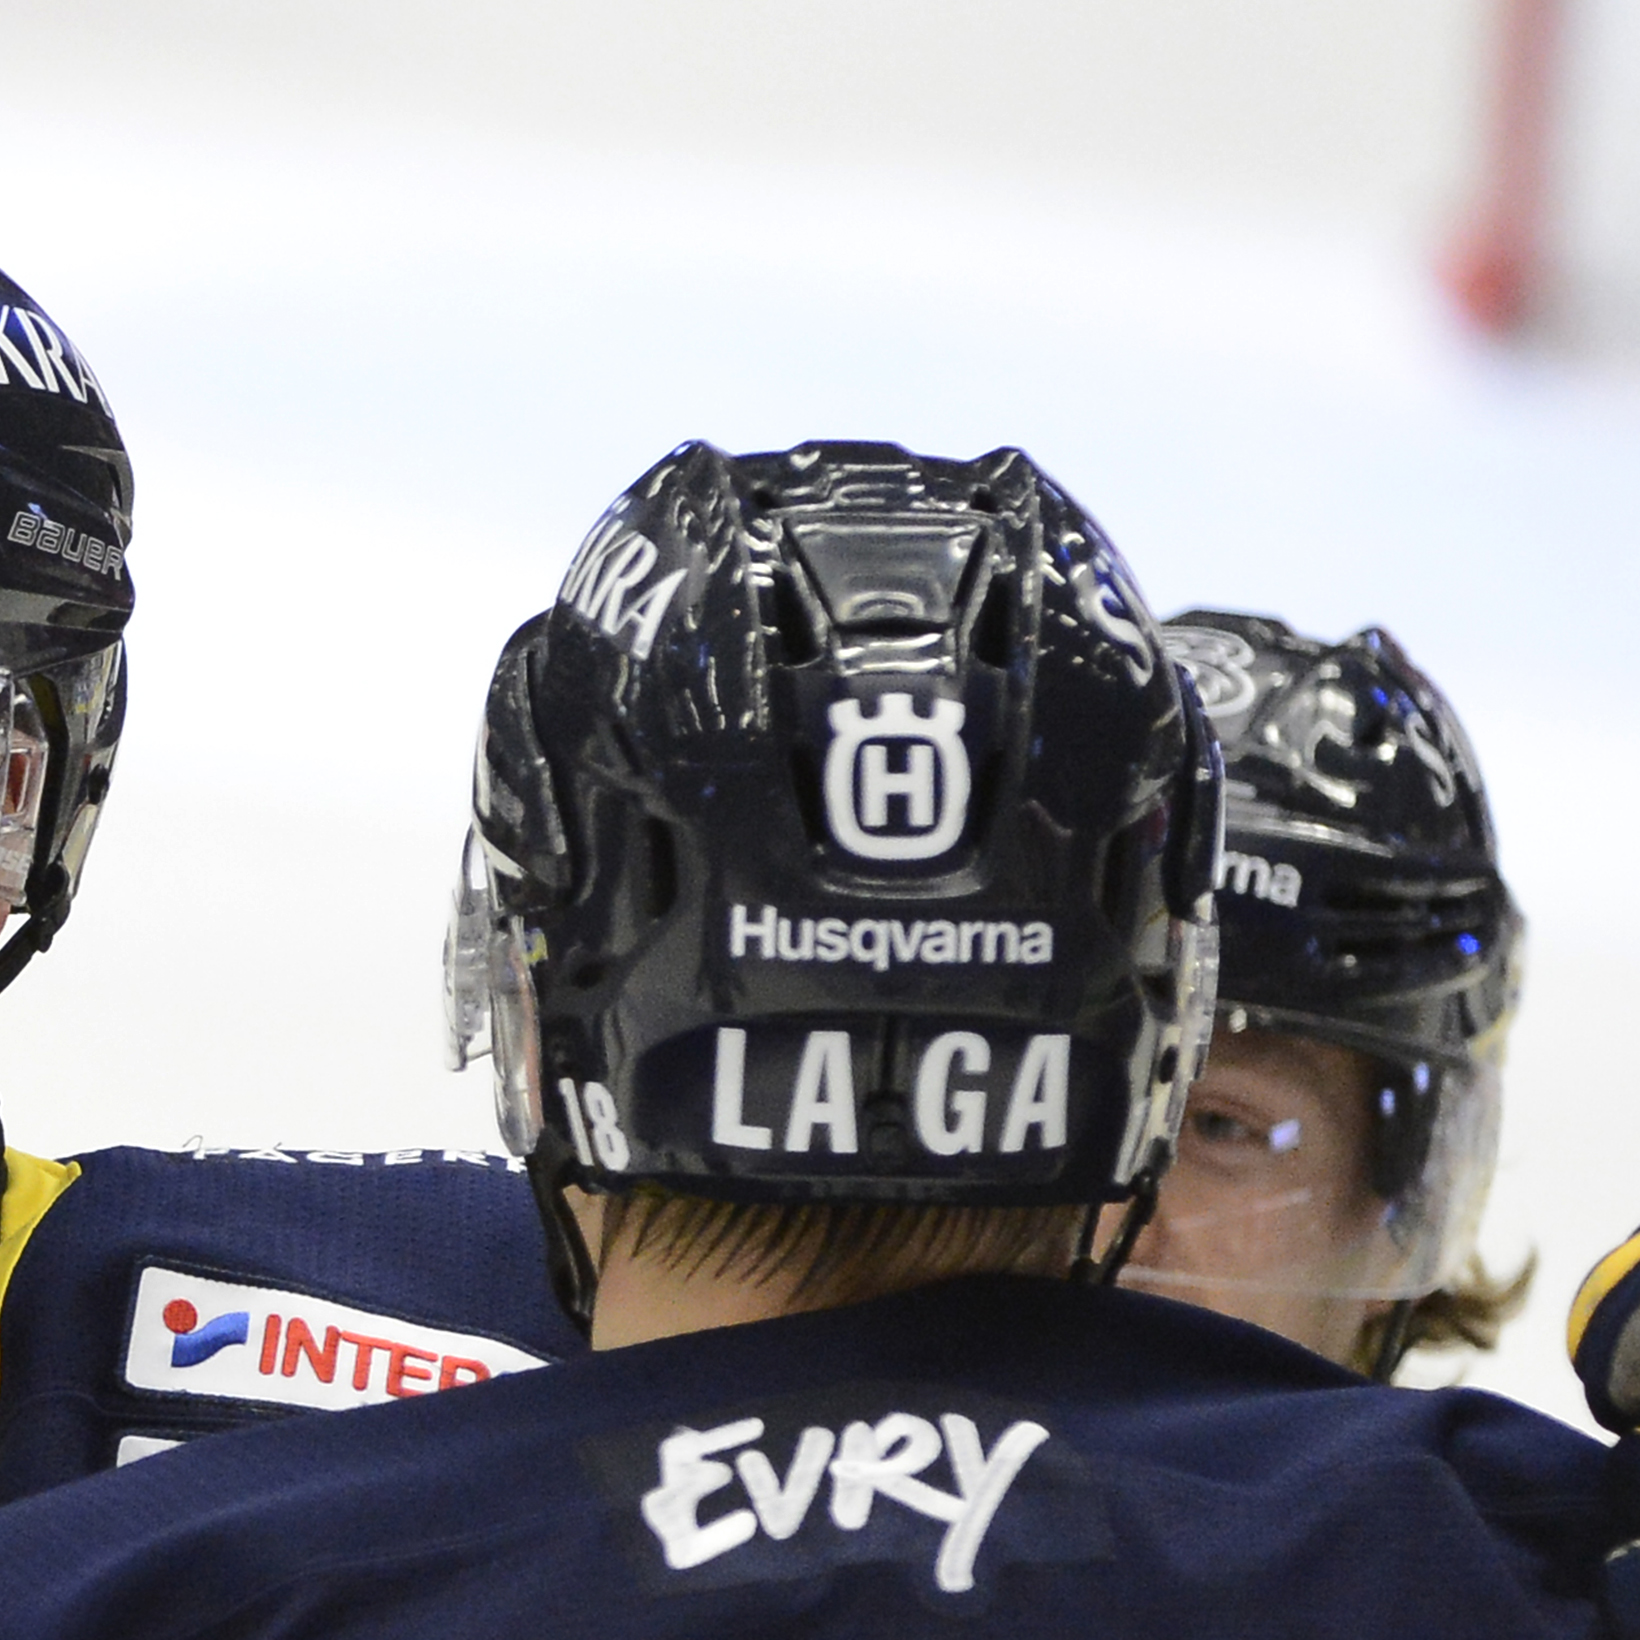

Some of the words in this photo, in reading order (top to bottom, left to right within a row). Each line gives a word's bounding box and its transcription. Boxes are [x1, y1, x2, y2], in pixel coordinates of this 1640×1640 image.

[7, 511, 125, 581] BAUER
[730, 903, 1053, 972] Husqvarna
[558, 1077, 631, 1173] 18
[259, 1313, 512, 1399] INTER
[640, 1411, 1050, 1592] EVRY
